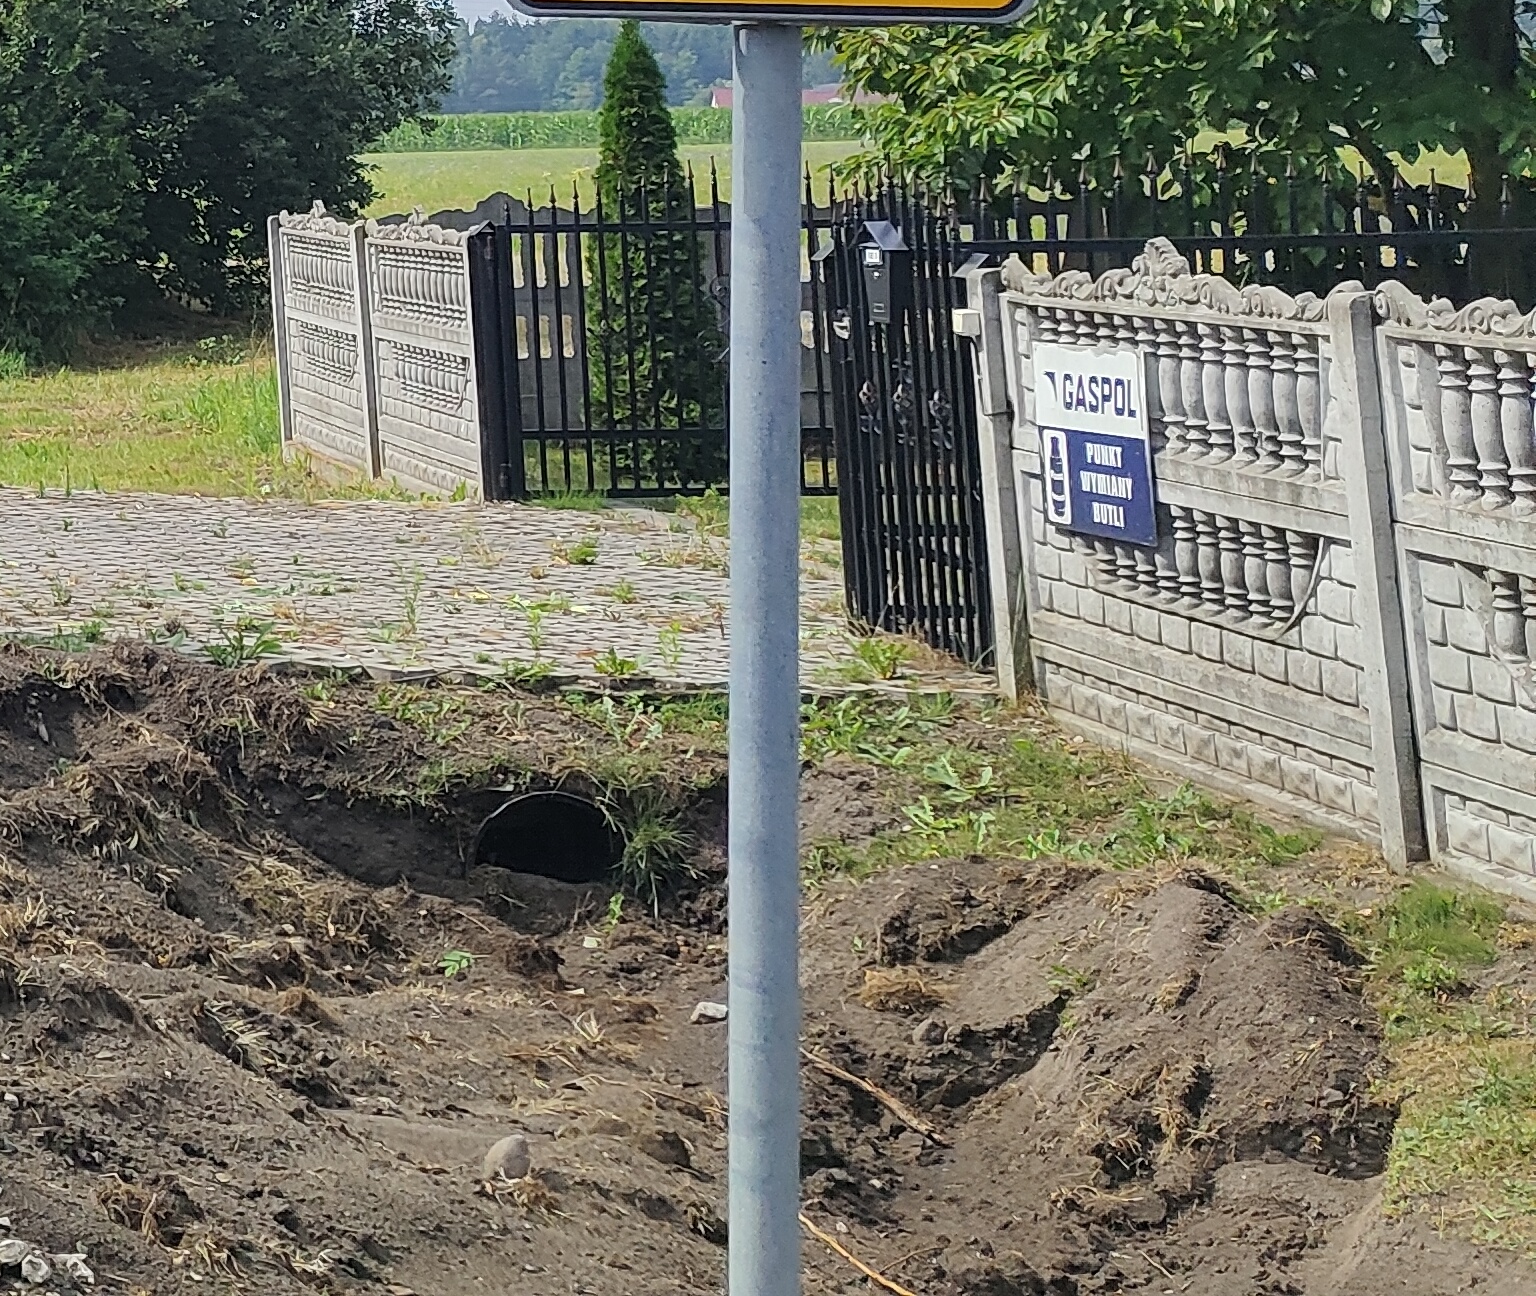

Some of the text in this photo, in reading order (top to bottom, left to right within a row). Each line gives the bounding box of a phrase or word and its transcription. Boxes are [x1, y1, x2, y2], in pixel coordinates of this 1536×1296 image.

[1063, 373, 1137, 418] GASPOL
[1084, 441, 1123, 468] PUNKT
[1079, 470, 1133, 500] WYMIANY
[1091, 501, 1125, 528] BUTLI
